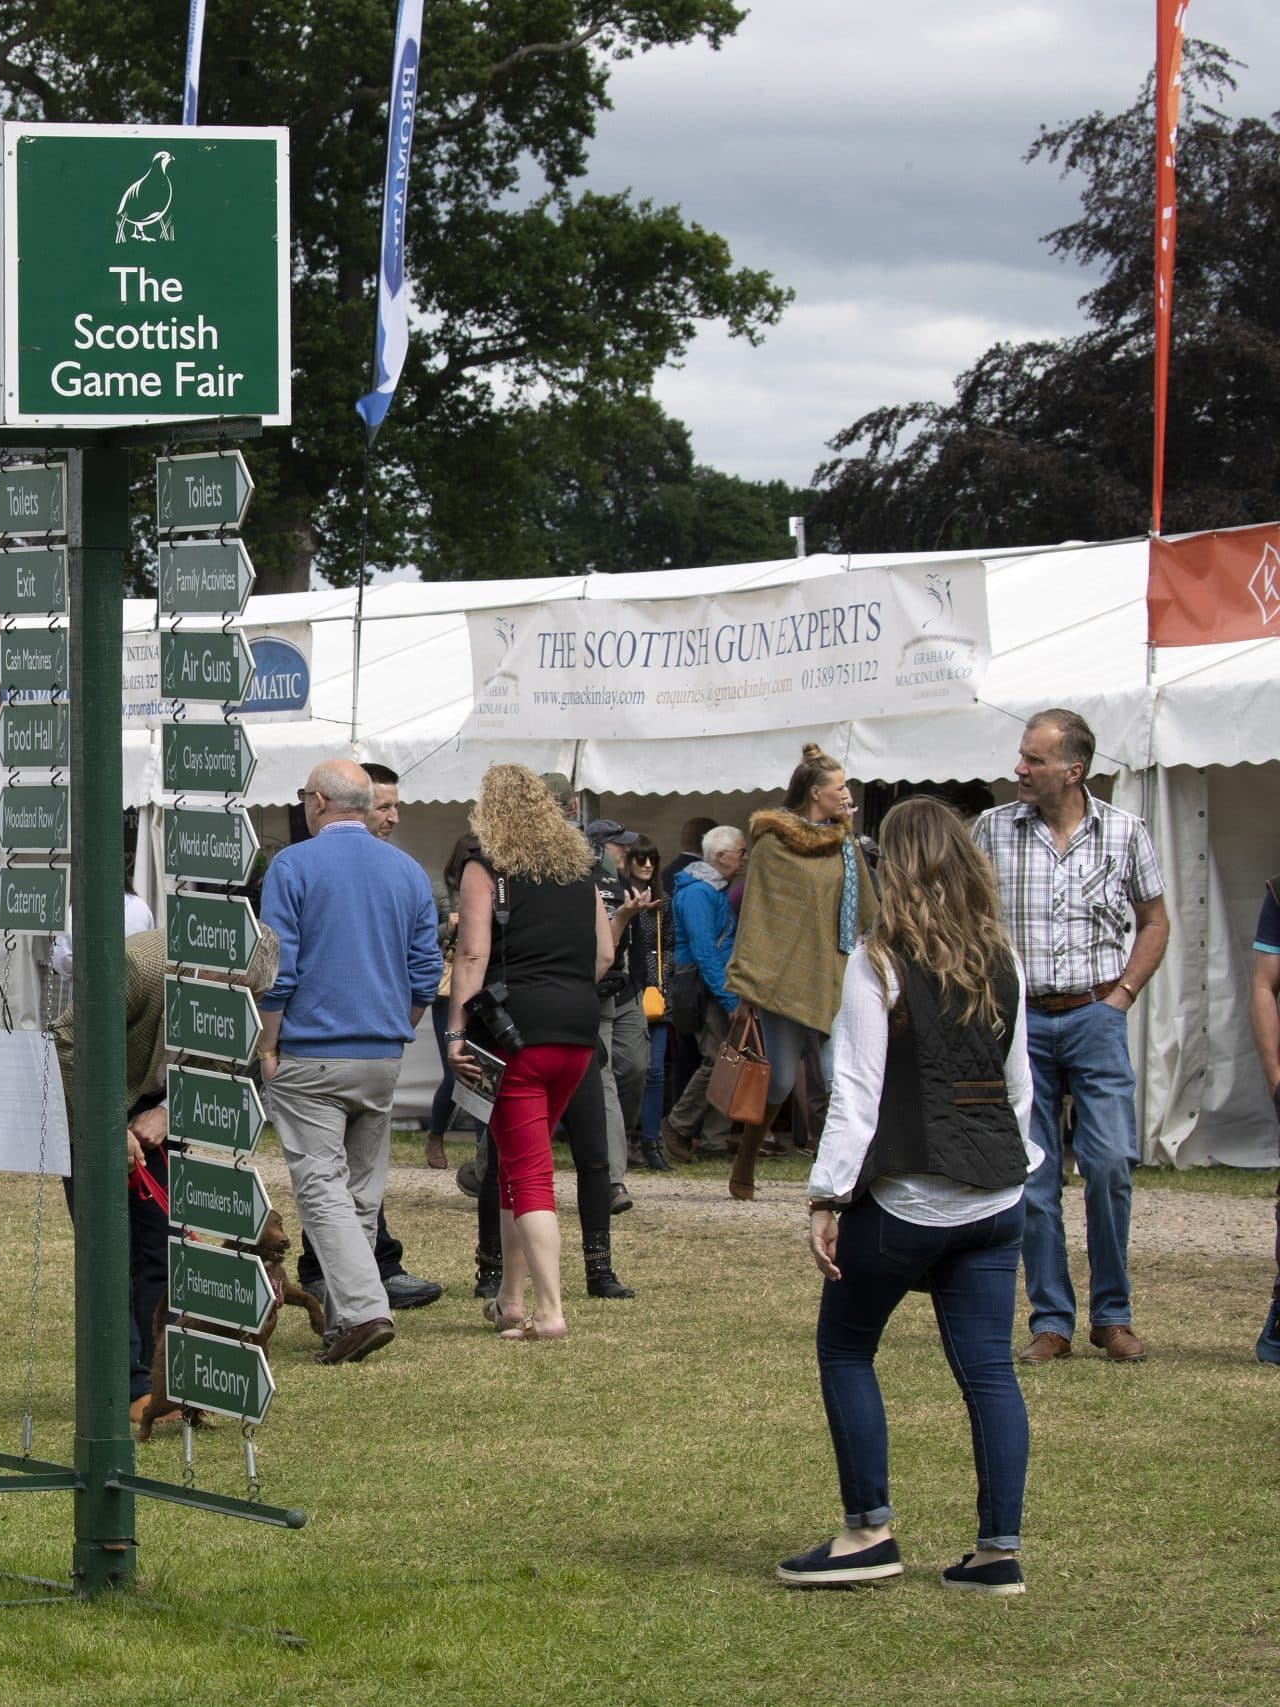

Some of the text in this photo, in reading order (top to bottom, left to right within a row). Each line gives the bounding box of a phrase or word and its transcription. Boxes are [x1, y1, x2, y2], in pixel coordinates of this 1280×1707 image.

[109, 267, 182, 302] The
[74, 314, 218, 350] Scottish
[51, 361, 243, 397] Game Fair
[7, 486, 39, 516] Toilets
[185, 475, 222, 508] Toilets
[16, 568, 36, 598] Exit
[176, 569, 236, 598] Family Activities
[538, 601, 881, 669] THE SCOTTISH GUN EXPERTS
[5, 649, 52, 671] Cash Machines
[181, 650, 231, 683] Air Guns
[914, 649, 955, 665] GRAHAM
[145, 674, 158, 689] 327
[801, 660, 879, 690] 01389 751122
[896, 668, 944, 687] MACKINLAY
[955, 666, 973, 680] CO
[533, 676, 793, 710] www.gmackinlay.com enquiries@gmackinlay.com
[7, 719, 53, 750] Food Hall
[183, 746, 236, 777] Clays Sporting
[4, 806, 54, 828] Woodland Row
[179, 831, 241, 866] World of Gundogs
[7, 883, 46, 923] Catering
[497, 877, 505, 903] Canon
[187, 914, 236, 960] Catering
[190, 1000, 234, 1040] Terriers
[193, 1092, 240, 1140] Archery
[186, 1181, 252, 1217] Gunmakers Row
[187, 1268, 254, 1305] Fishermans Row
[195, 1354, 249, 1407] Falconry
